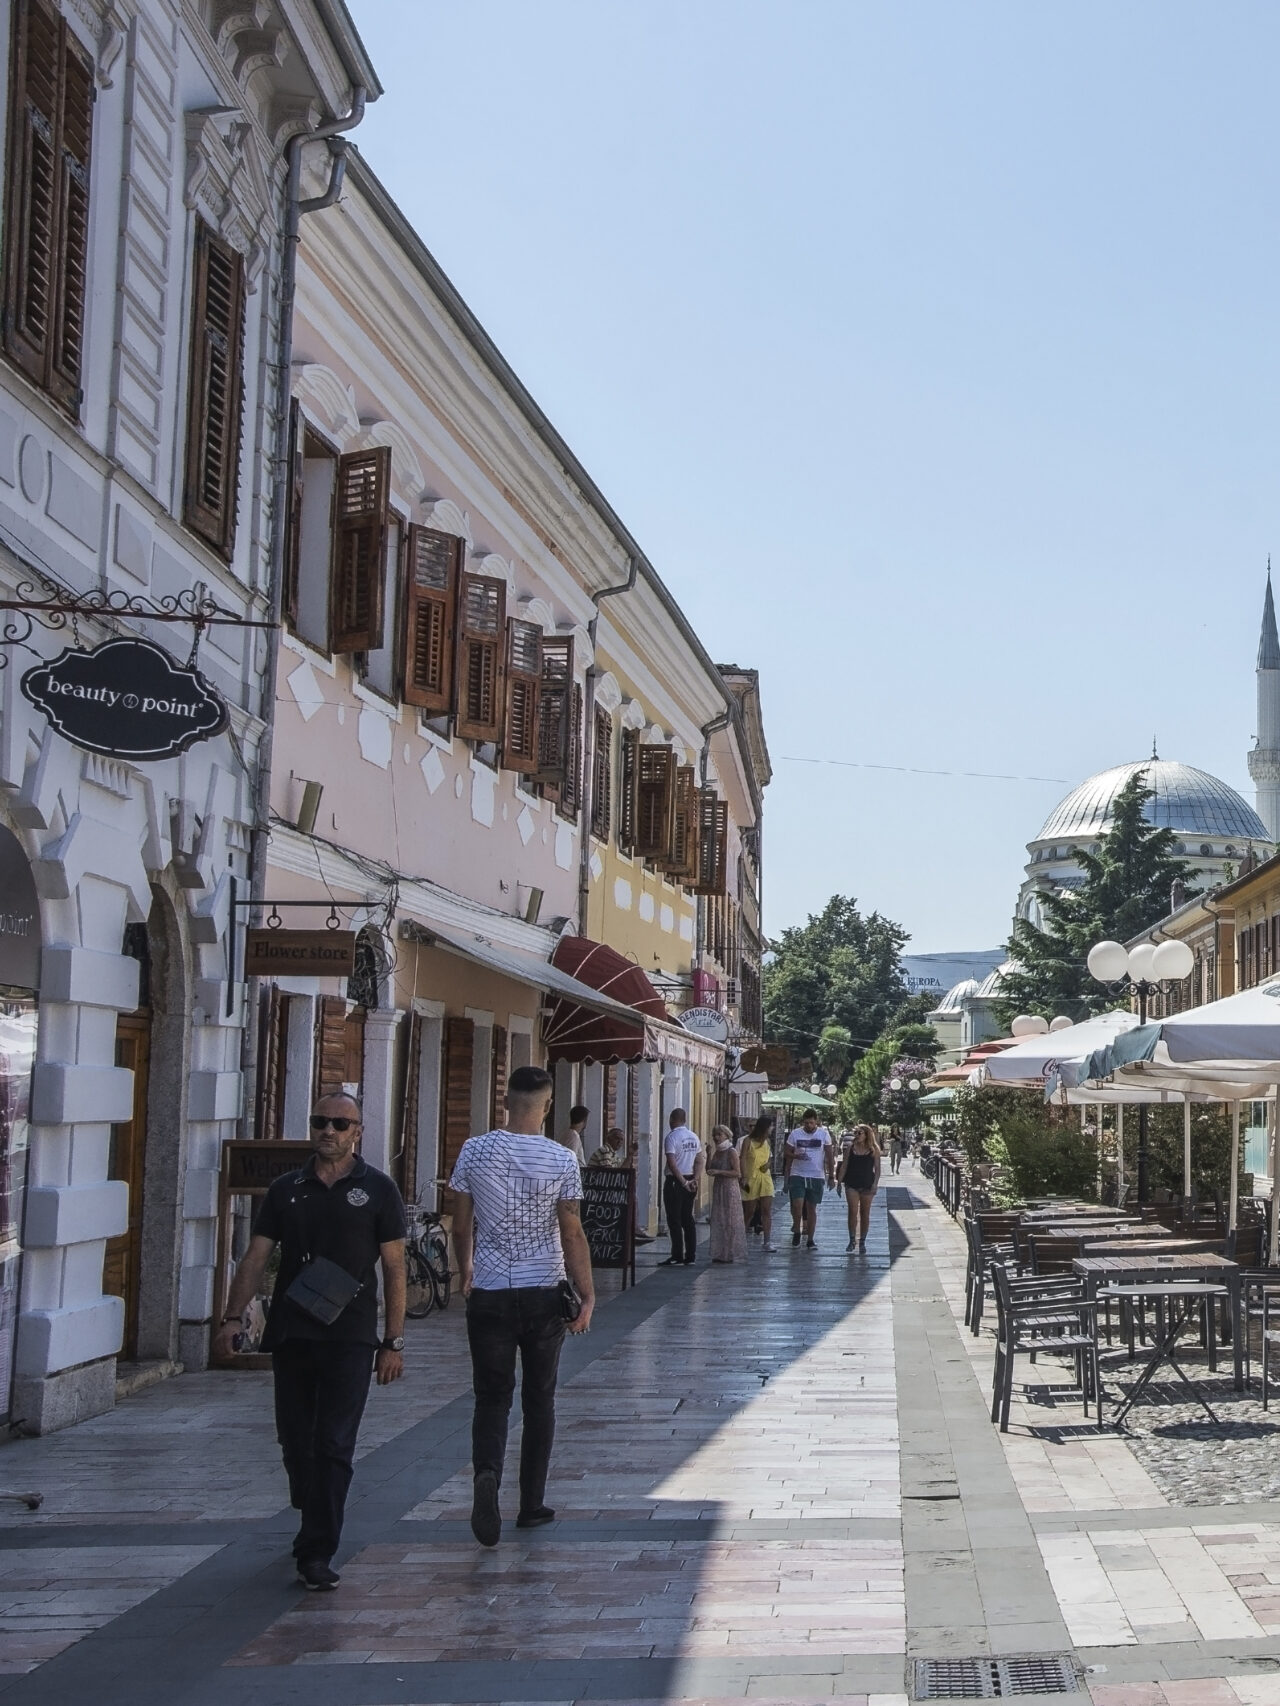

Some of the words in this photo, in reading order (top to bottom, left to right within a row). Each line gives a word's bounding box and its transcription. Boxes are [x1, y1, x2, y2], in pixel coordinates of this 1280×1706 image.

[47, 675, 121, 707] beauty
[141, 697, 200, 718] point
[255, 941, 308, 959] Flower
[309, 945, 349, 960] store
[907, 976, 942, 987] EUROPA
[586, 1204, 621, 1220] FOOD
